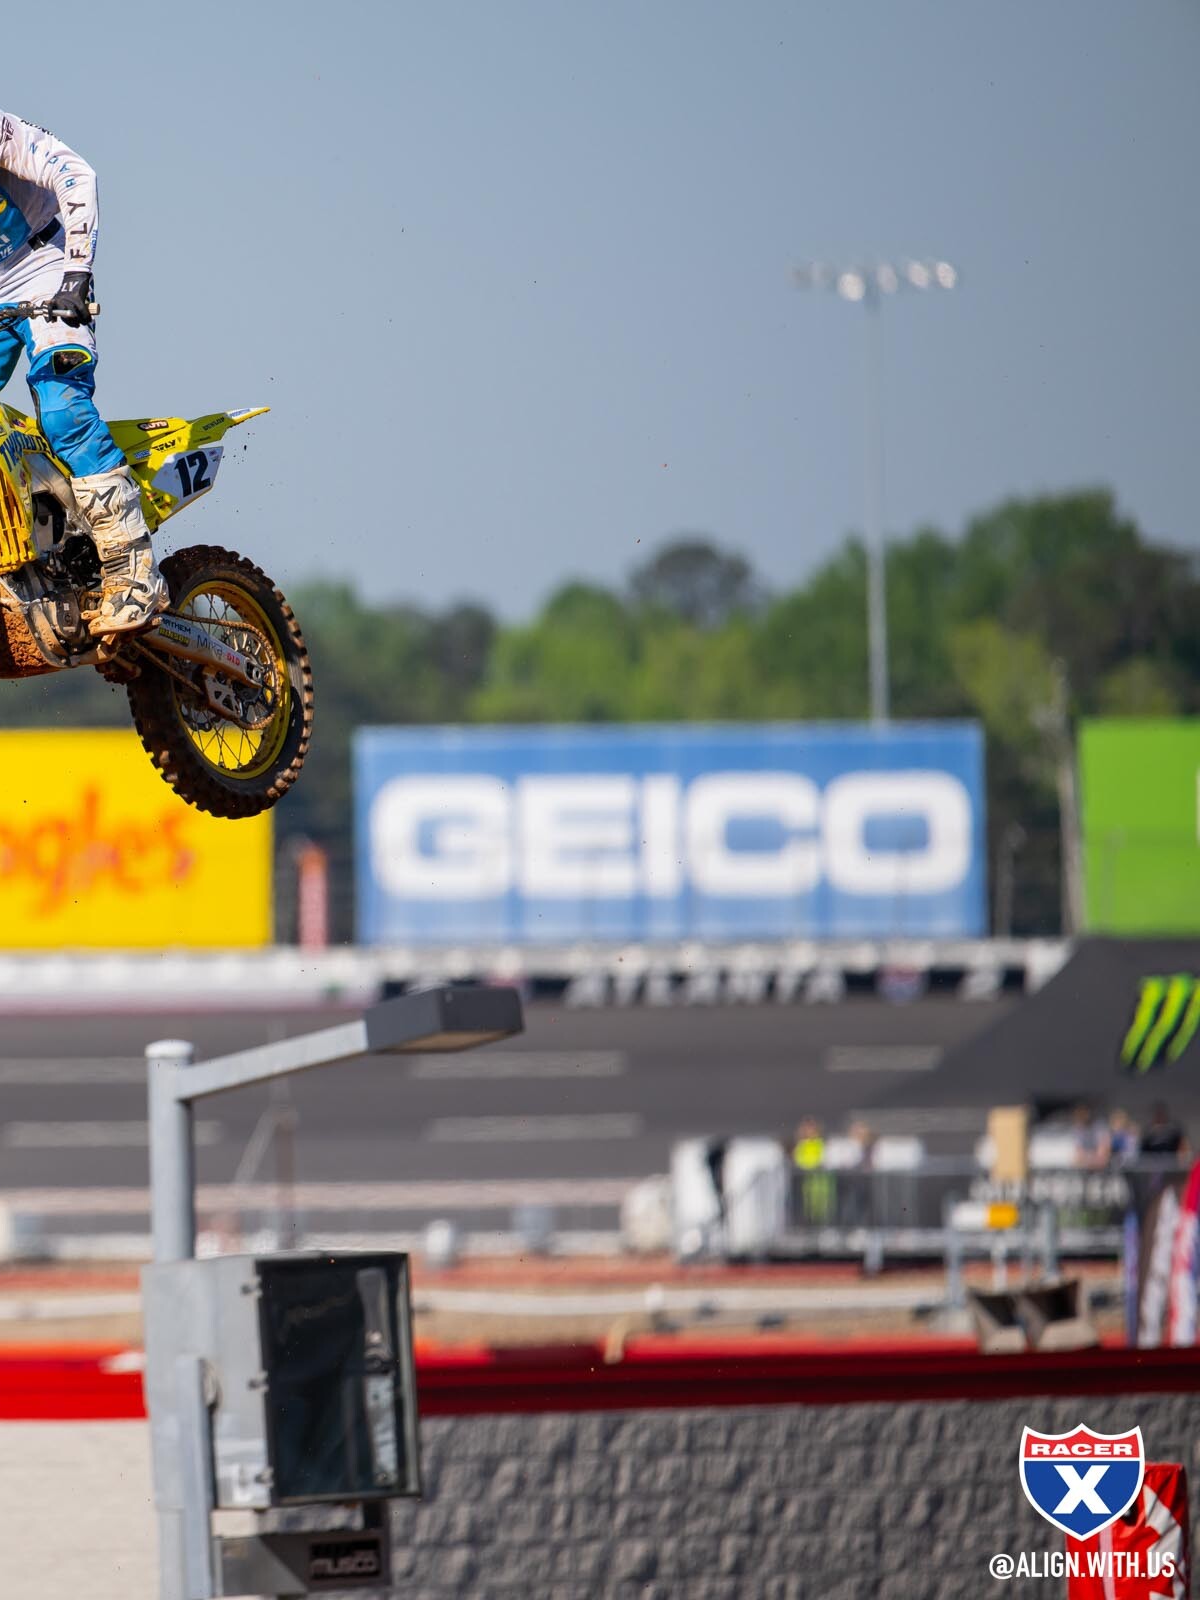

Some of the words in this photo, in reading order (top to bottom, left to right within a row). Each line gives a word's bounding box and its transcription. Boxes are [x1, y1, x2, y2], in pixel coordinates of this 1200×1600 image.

[67, 201, 87, 259] FLY
[61, 281, 80, 292] LY
[140, 421, 168, 430] GUTS
[174, 451, 211, 498] 12
[369, 769, 974, 900] GEICO
